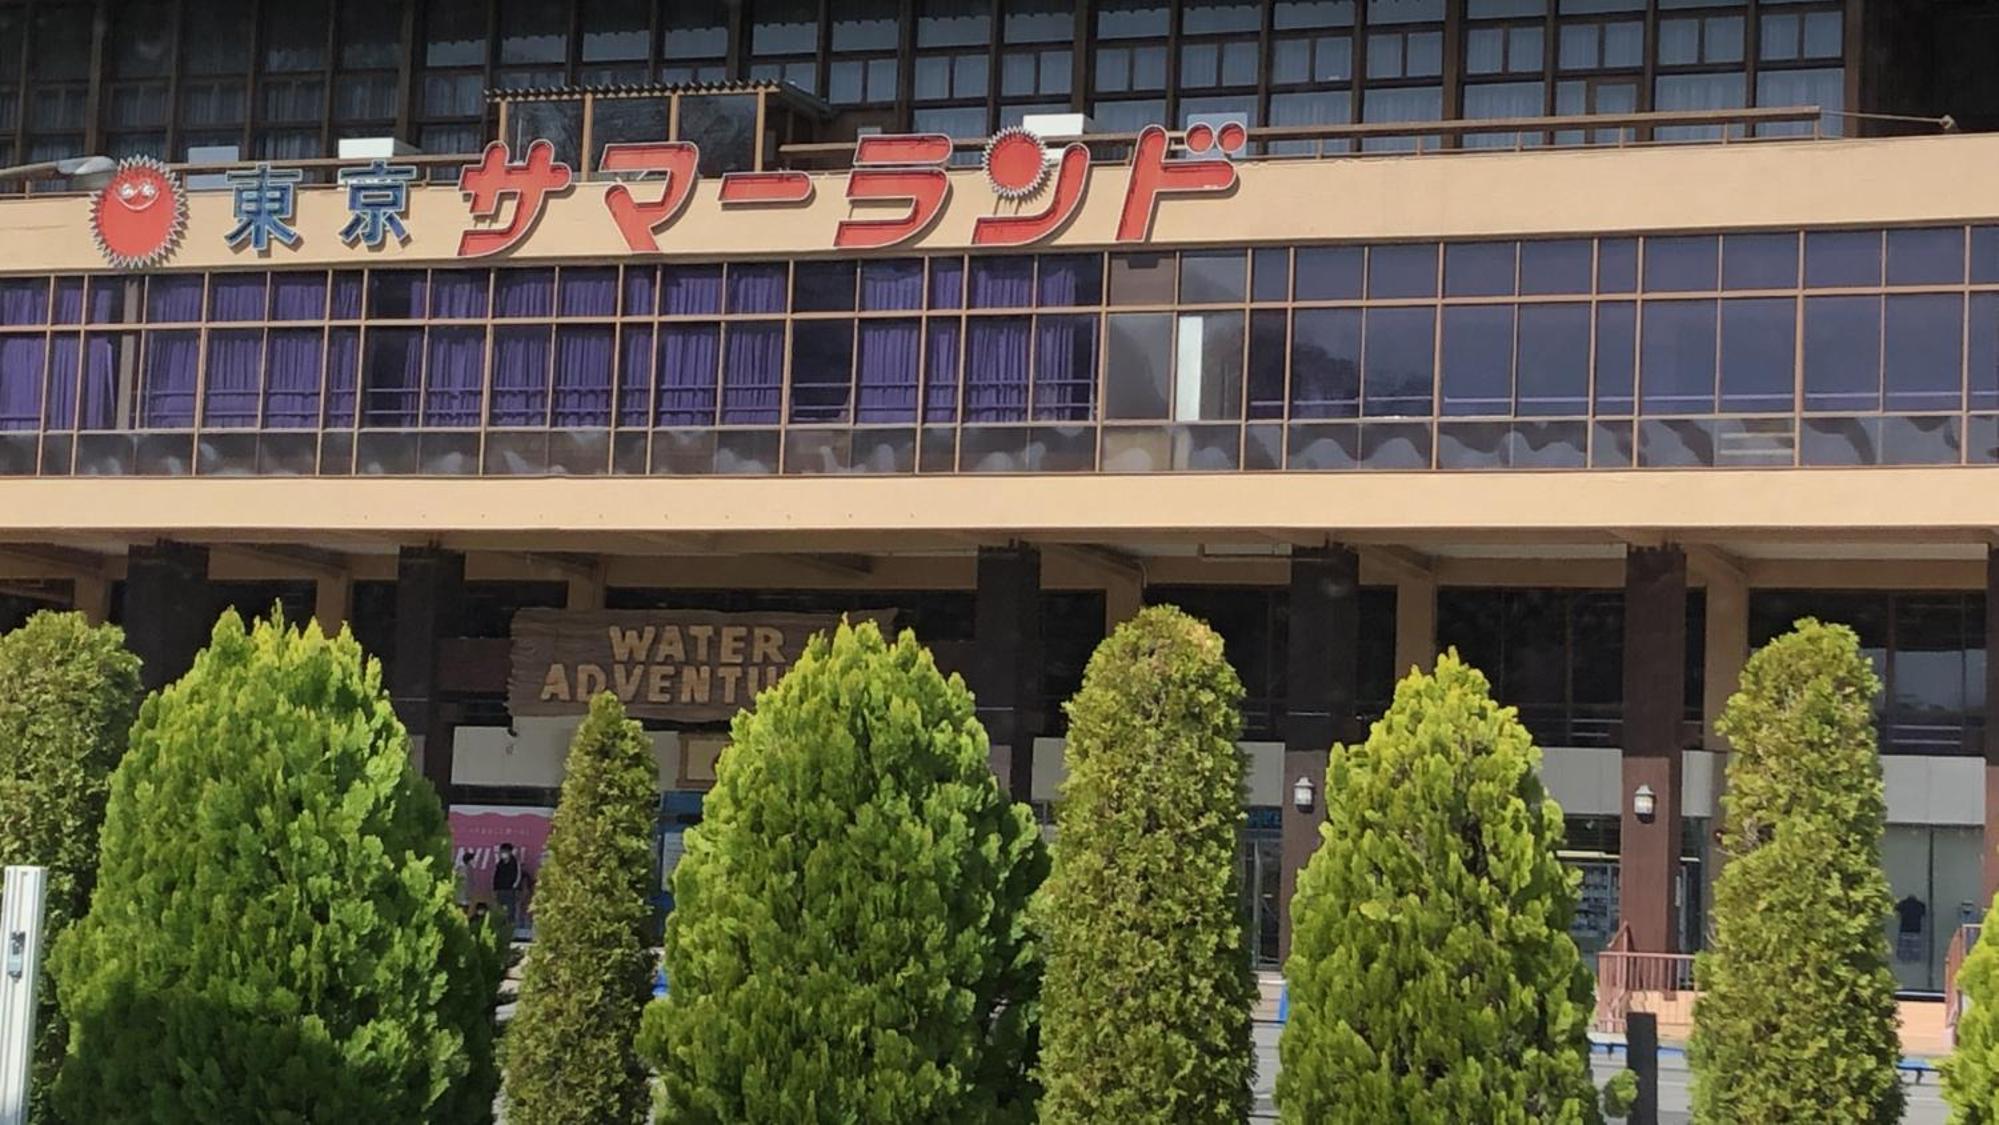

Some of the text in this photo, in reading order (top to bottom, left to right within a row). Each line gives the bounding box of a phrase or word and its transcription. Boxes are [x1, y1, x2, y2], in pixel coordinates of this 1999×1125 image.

[225, 121, 1248, 258] 東京サマーランド
[608, 625, 787, 663] WATER
[540, 663, 795, 704] ADVENTU
